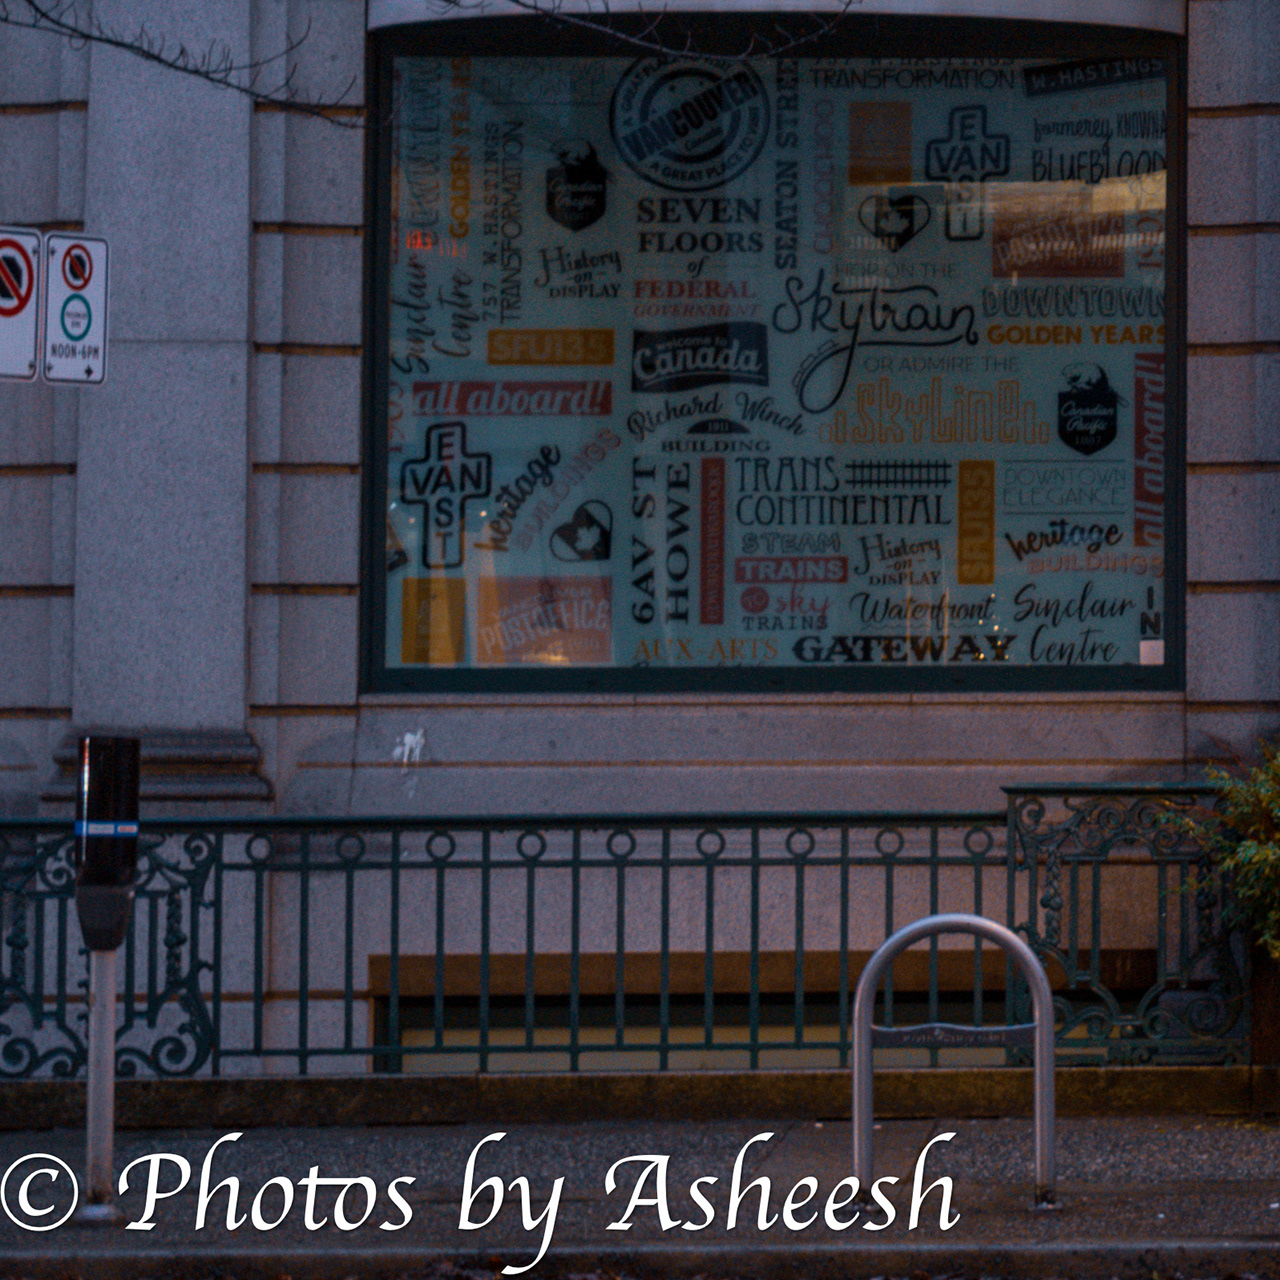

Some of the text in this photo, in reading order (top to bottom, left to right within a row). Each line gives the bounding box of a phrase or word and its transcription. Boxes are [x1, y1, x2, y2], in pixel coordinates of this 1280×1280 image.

[808, 68, 1014, 89] TRANSFORMATION
[622, 70, 760, 163] VANCOUVER
[934, 141, 1003, 174] VAN
[449, 143, 471, 238] GOLDEN
[500, 120, 525, 325] TRANSFORMATION
[637, 197, 762, 224] SEVEN
[774, 159, 799, 270] SEATON
[637, 232, 764, 254] FLOORS
[534, 244, 623, 288] History
[686, 254, 710, 279] of
[483, 282, 499, 322] 757
[548, 282, 622, 299] DISPLAY
[633, 279, 757, 299] FEDERAL
[981, 284, 1166, 318] DOWNTOWN
[632, 303, 761, 317] GOVERNMENT
[772, 267, 979, 415] Skytrain
[986, 324, 1166, 345] GOLDEN YEARS
[633, 339, 764, 381] Canada
[900, 355, 976, 372] ADMIRE
[412, 381, 460, 415] all
[626, 391, 807, 442] Richard Winch
[661, 439, 771, 453] BUILDING
[408, 459, 484, 496] VAN
[734, 455, 840, 493] TRANS
[472, 444, 562, 553] heritage
[735, 494, 952, 526] CONTINENTAL
[666, 461, 691, 625] HOWE
[741, 531, 842, 554] STEAM
[853, 532, 942, 576] History
[1003, 517, 1125, 562] heritage
[739, 560, 845, 580] TRAINS
[868, 571, 942, 586] DISPLAY
[1012, 579, 1137, 628] Sinclair
[740, 615, 829, 632] TRAINS
[790, 634, 1018, 663] GATEWAY
[1029, 623, 1121, 665] Centre
